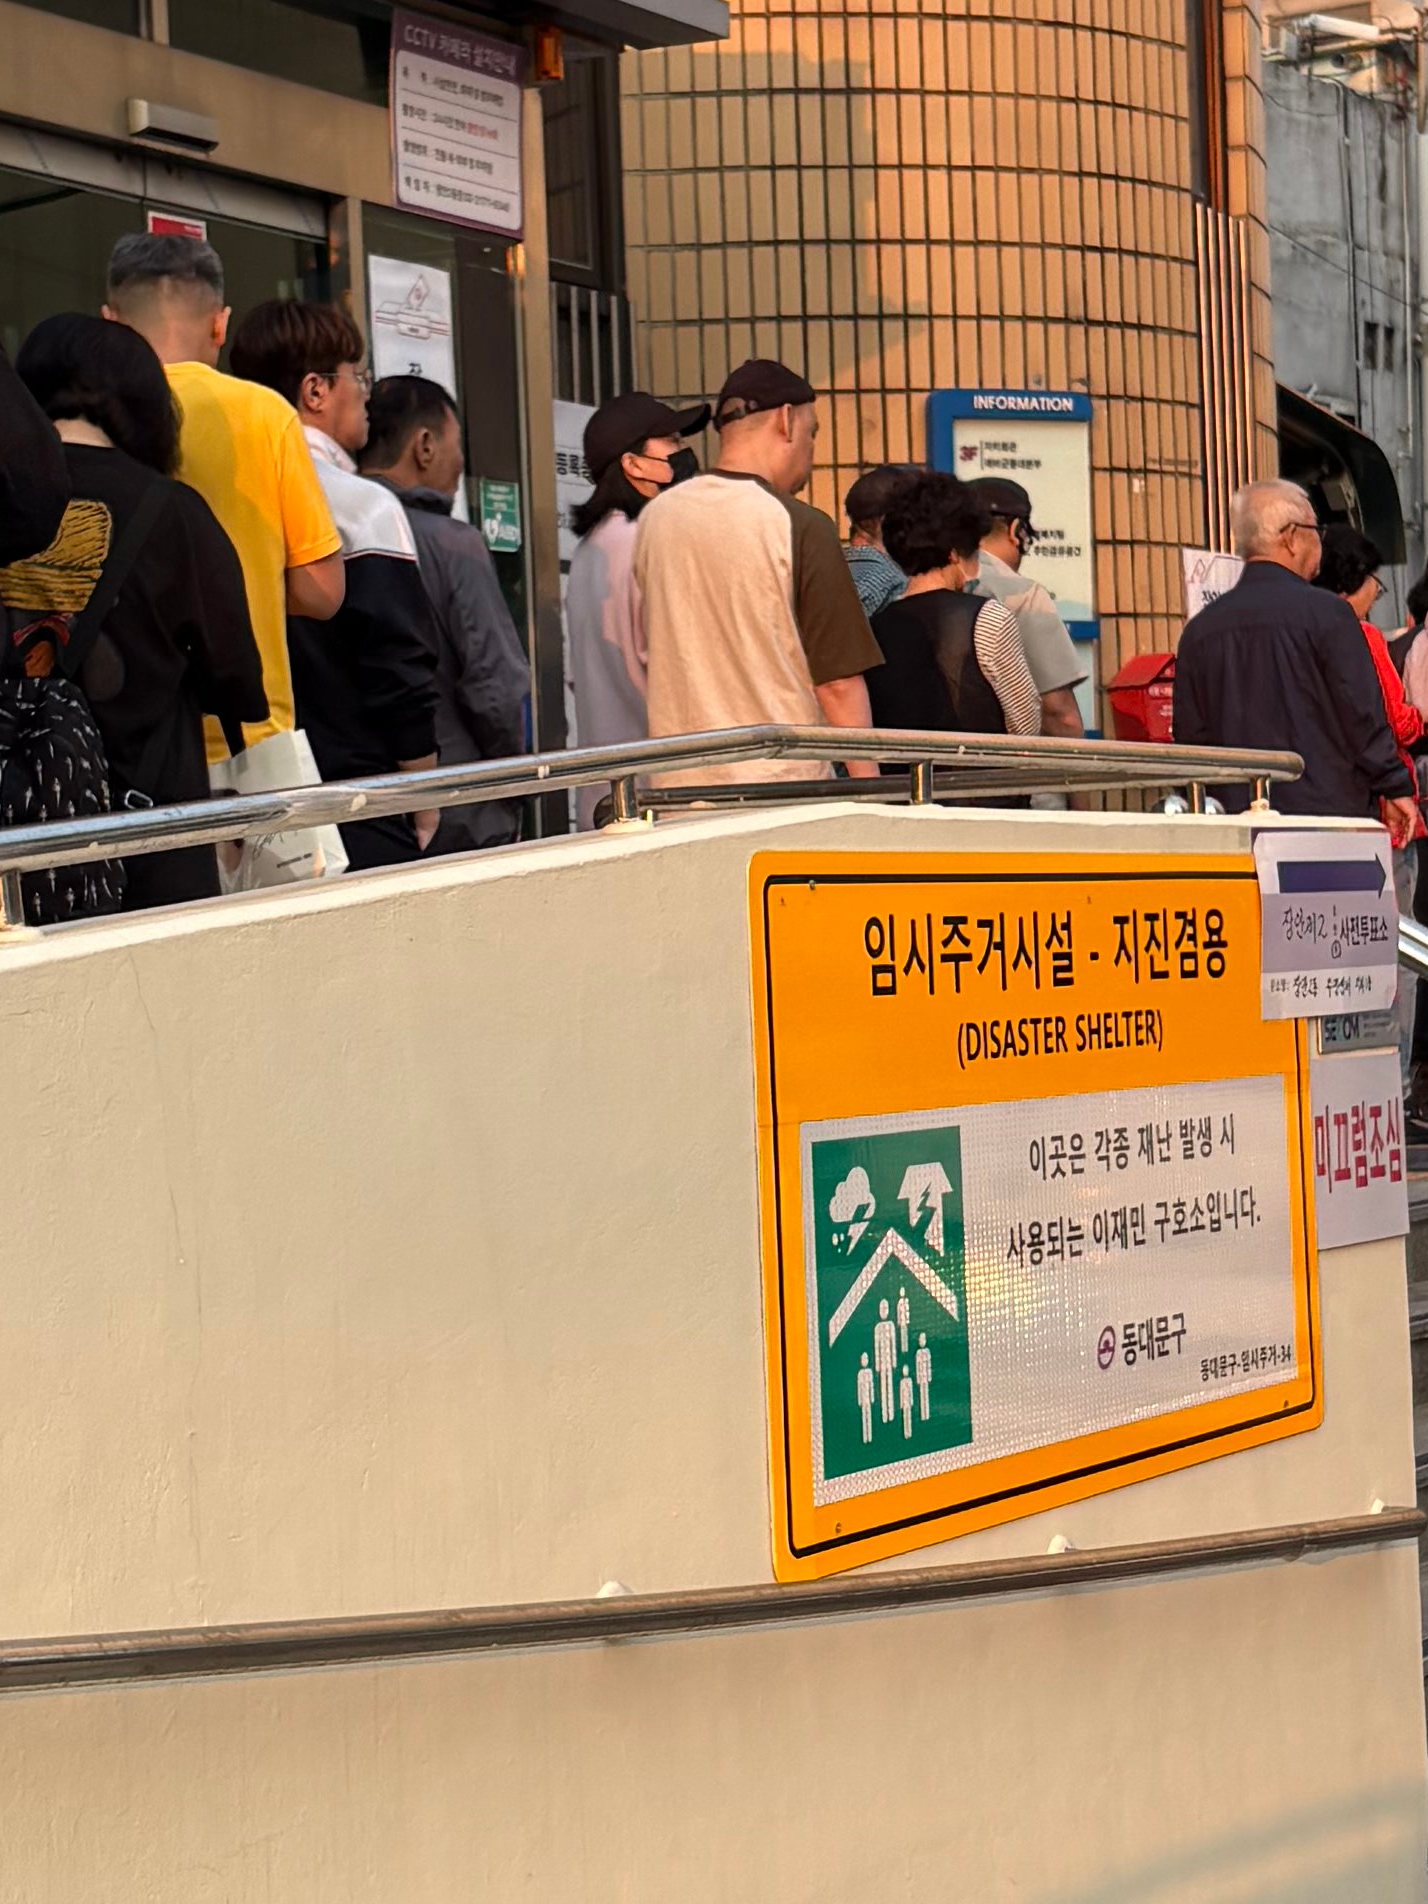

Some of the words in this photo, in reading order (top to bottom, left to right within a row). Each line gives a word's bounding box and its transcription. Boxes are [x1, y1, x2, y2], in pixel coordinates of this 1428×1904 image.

[404, 24, 436, 47] CCTV
[973, 394, 1074, 412] INFORMATION
[959, 445, 979, 462] 3F
[863, 909, 1075, 998] 임시주거시설
[1112, 908, 1230, 985] 지진겸용
[957, 1017, 1069, 1070] (DISASTER
[1075, 1008, 1164, 1054] SHELTER)
[1029, 1132, 1087, 1181] 이곳은
[1094, 1127, 1131, 1172] 각종
[1137, 1121, 1173, 1166] 재난
[1179, 1115, 1213, 1160] 발생
[1220, 1112, 1236, 1155] 시
[1314, 1097, 1402, 1194] 미끄럼조심
[1006, 1215, 1085, 1268] 사용되는
[1092, 1202, 1147, 1253] 이재민
[1153, 1185, 1262, 1244] 구호소입니다.
[1121, 1312, 1188, 1367] 동대문구
